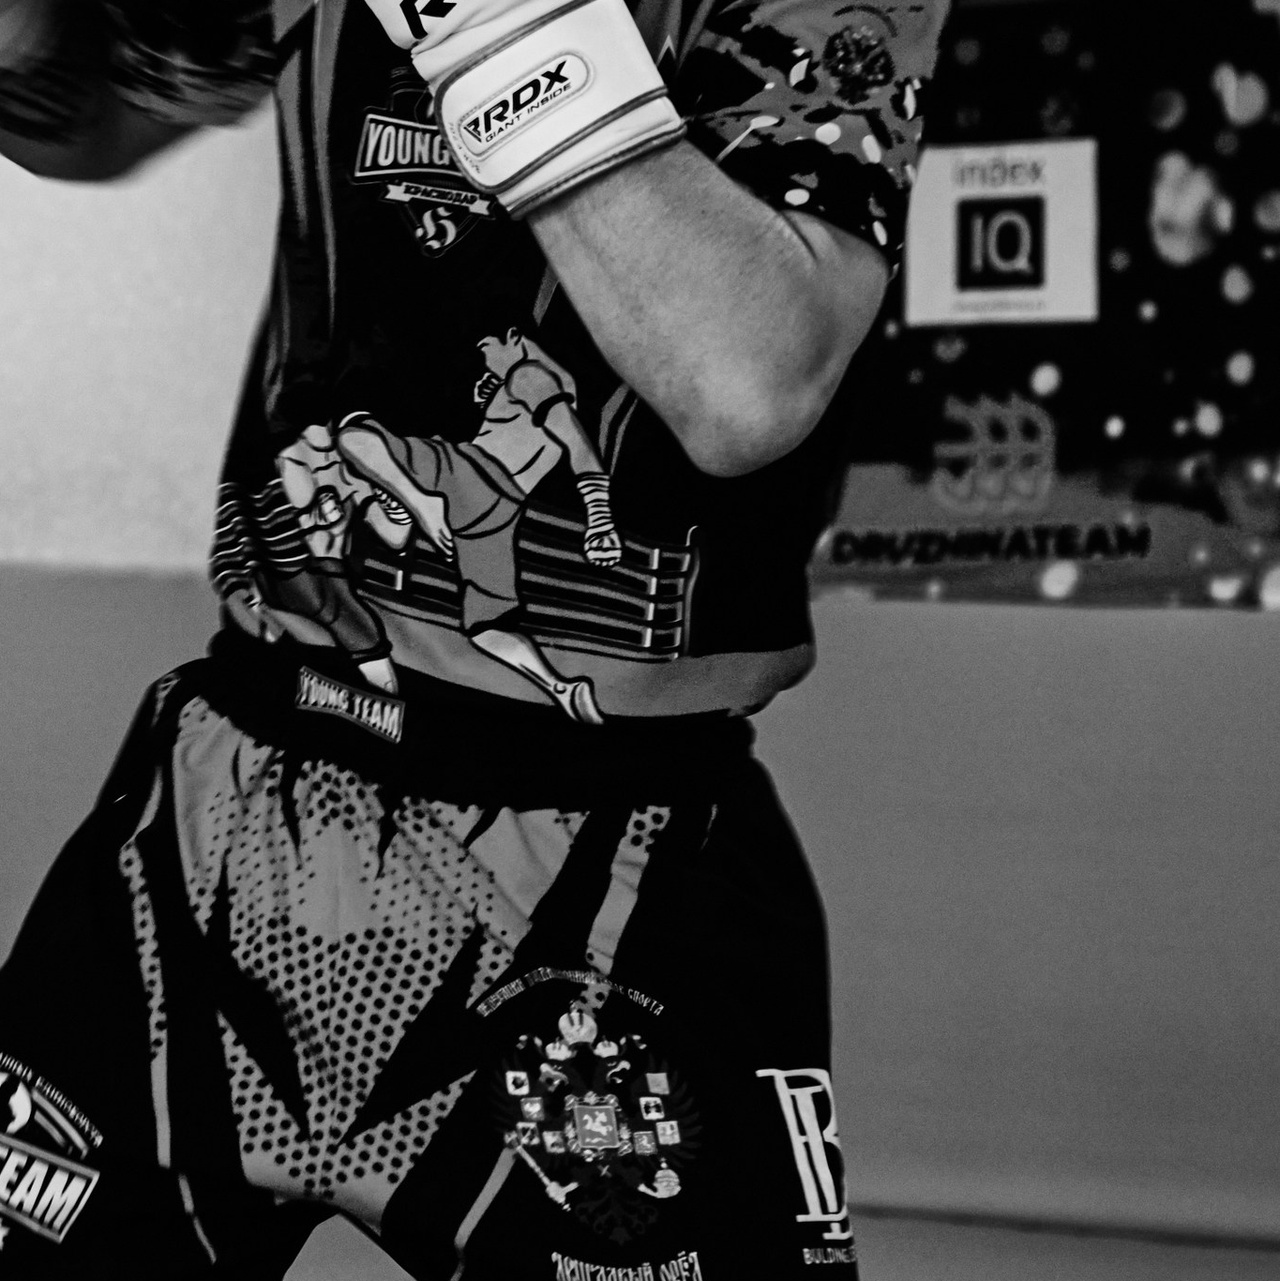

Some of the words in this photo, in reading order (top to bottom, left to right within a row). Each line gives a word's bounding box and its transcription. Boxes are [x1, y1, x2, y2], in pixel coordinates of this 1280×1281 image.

[485, 113, 522, 143] GIANT
[527, 81, 572, 114] INSIDE
[363, 122, 451, 168] YOUNG
[969, 208, 1035, 277] IQ
[351, 693, 401, 742] TEAM
